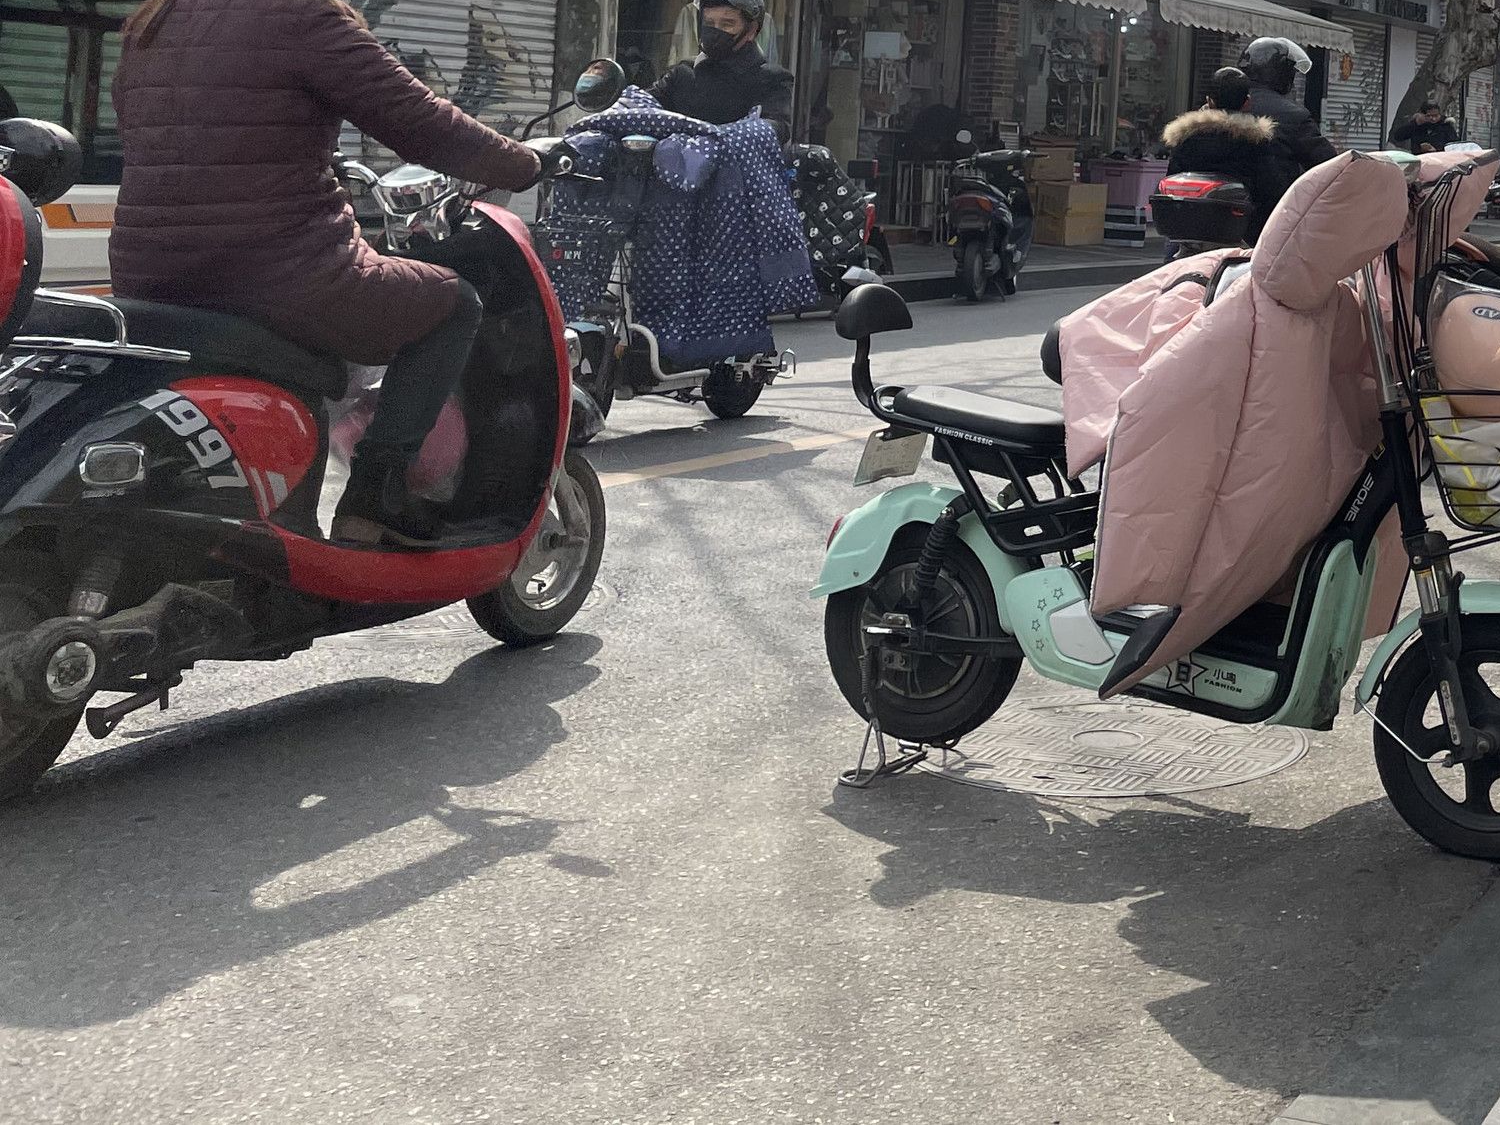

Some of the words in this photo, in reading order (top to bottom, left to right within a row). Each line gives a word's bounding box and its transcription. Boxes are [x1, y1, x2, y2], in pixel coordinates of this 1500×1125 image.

[136, 387, 250, 489] 1997
[934, 426, 964, 439] FASHION
[964, 433, 994, 447] CLASSIC
[1204, 678, 1243, 693] FASHION
